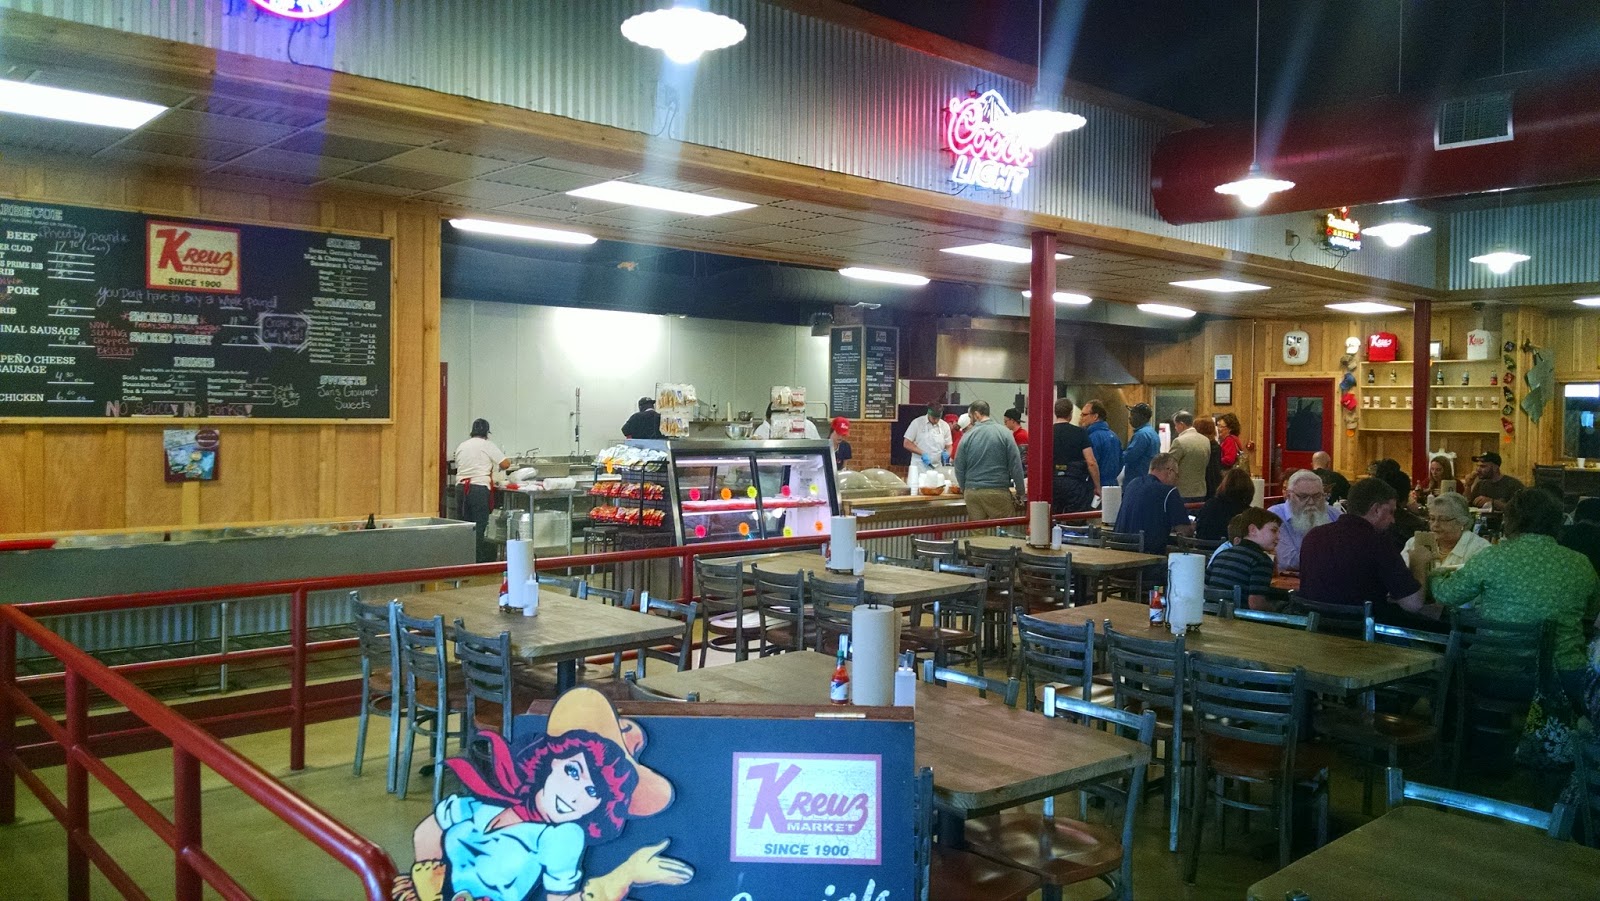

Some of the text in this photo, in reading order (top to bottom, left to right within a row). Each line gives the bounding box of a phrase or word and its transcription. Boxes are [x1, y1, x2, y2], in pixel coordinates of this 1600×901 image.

[952, 154, 1030, 194] LIGHT
[7, 231, 39, 242] BEEF
[11, 244, 33, 254] CLOD
[156, 227, 233, 276] Kreuz
[7, 260, 30, 269] PRIME
[31, 262, 44, 271] RIB
[169, 277, 222, 288] SINCE 1900
[7, 285, 40, 295] PORK
[30, 325, 80, 336] SAUSAGE
[33, 355, 77, 366] CHEESE
[0, 365, 47, 374] AUSAGE
[0, 393, 45, 403] CHICKEN
[334, 396, 371, 410] Sweets
[746, 762, 869, 835] Kreuz
[786, 822, 856, 833] MARKET
[764, 843, 849, 857] SINCE 1900
